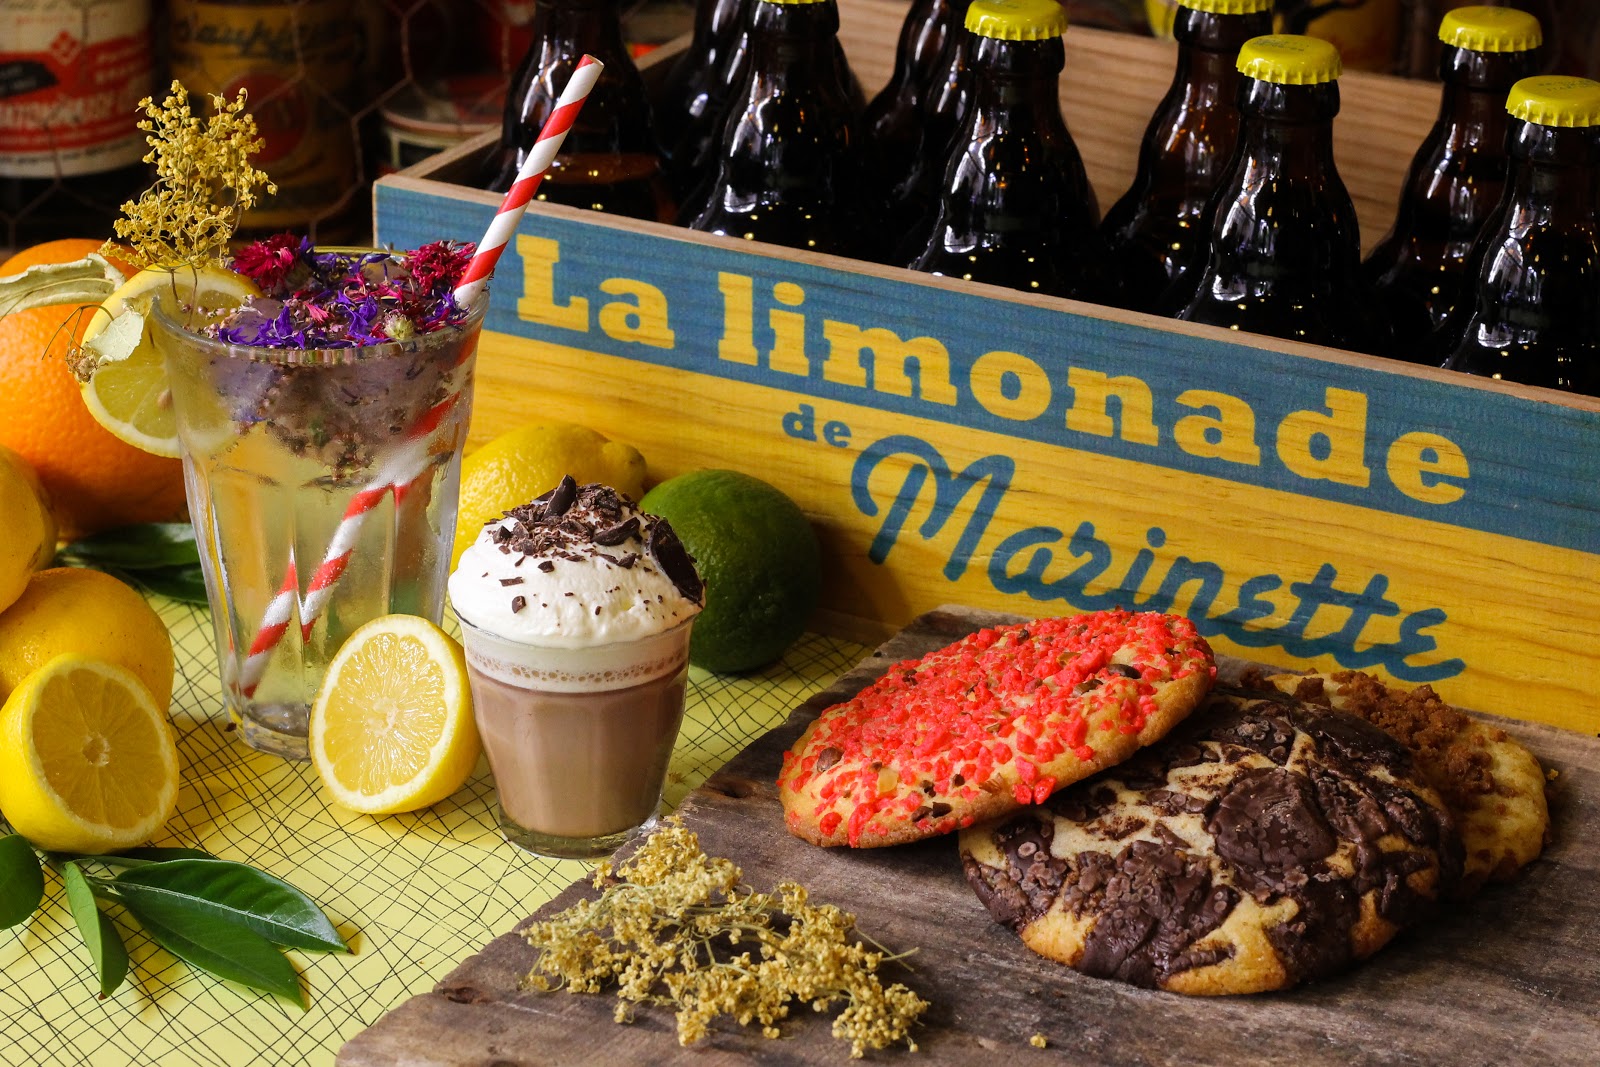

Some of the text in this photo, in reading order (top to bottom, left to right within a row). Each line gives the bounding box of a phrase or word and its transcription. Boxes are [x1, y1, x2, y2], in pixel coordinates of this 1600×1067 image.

[516, 233, 1471, 505] La limonade
[782, 403, 853, 448] de
[851, 434, 1466, 682] Marinette
